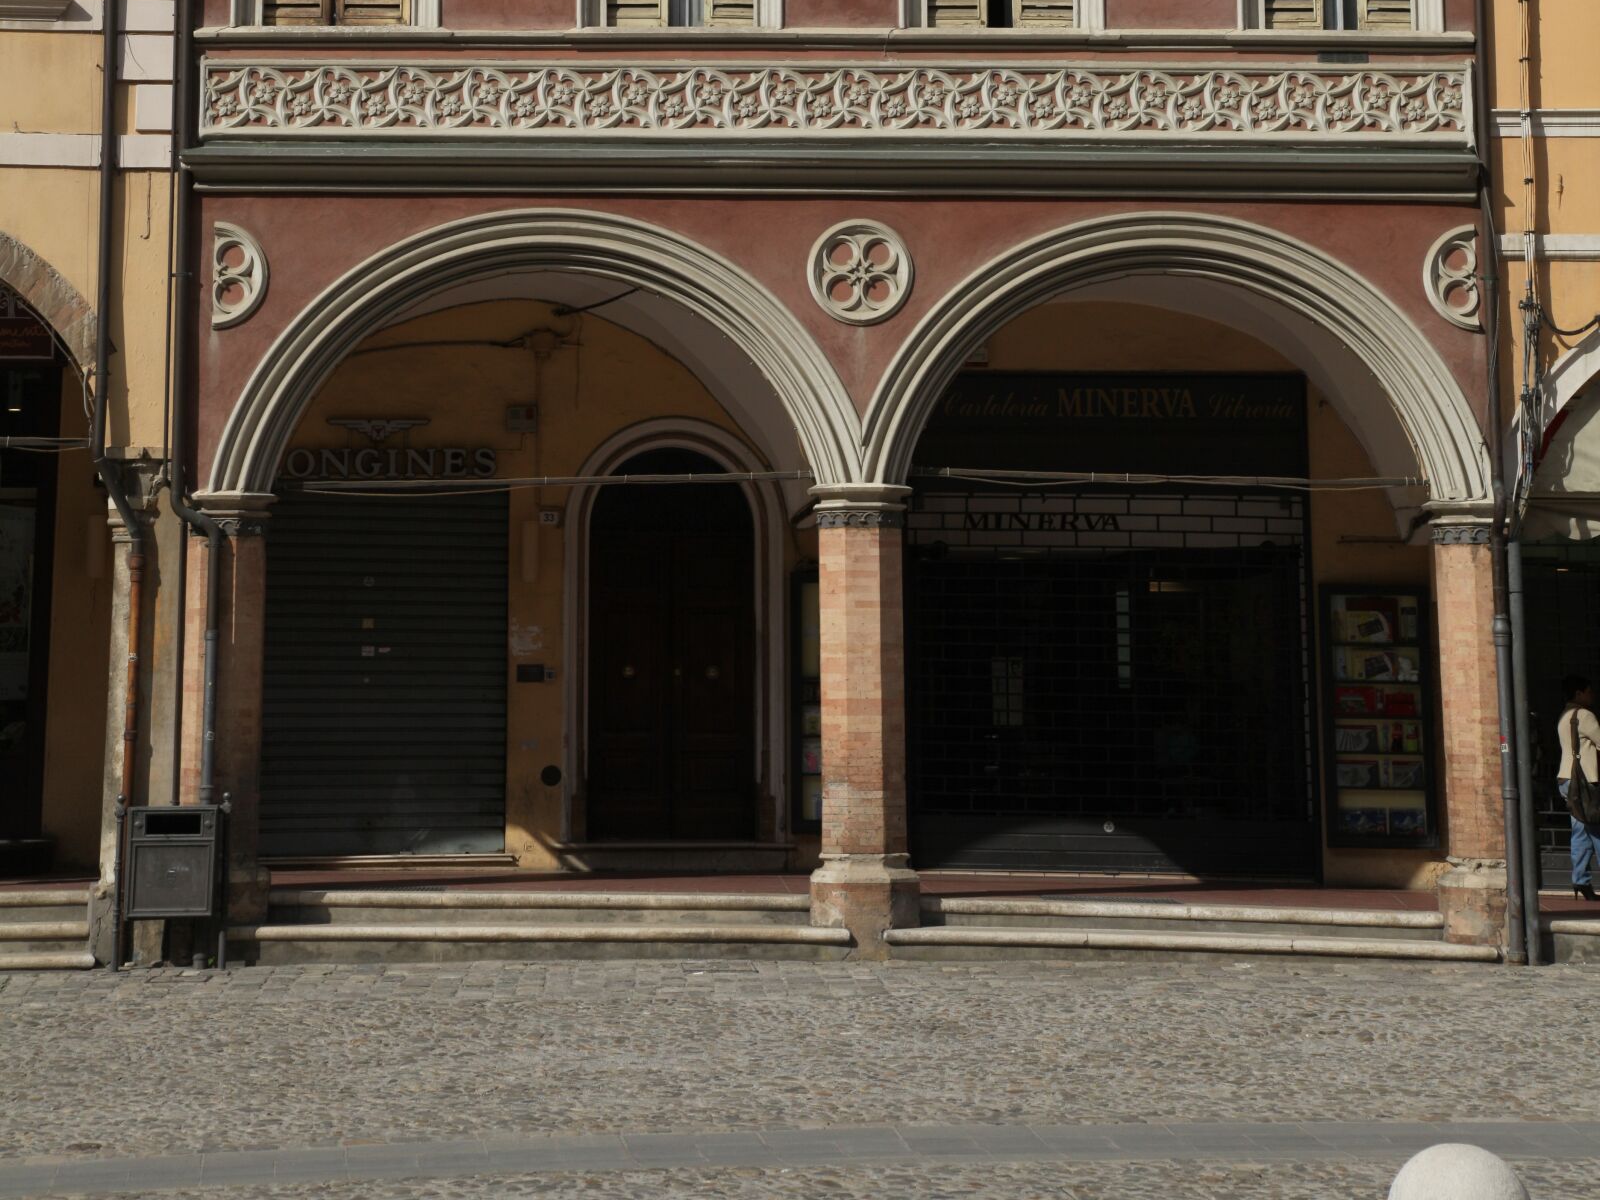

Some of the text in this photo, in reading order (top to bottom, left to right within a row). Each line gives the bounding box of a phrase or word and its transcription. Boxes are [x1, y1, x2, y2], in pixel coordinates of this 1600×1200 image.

[1056, 388, 1196, 417] MINERVA
[1208, 391, 1297, 417] Libreria
[279, 448, 497, 477] ONGINES
[962, 513, 1120, 531] MINERVA
